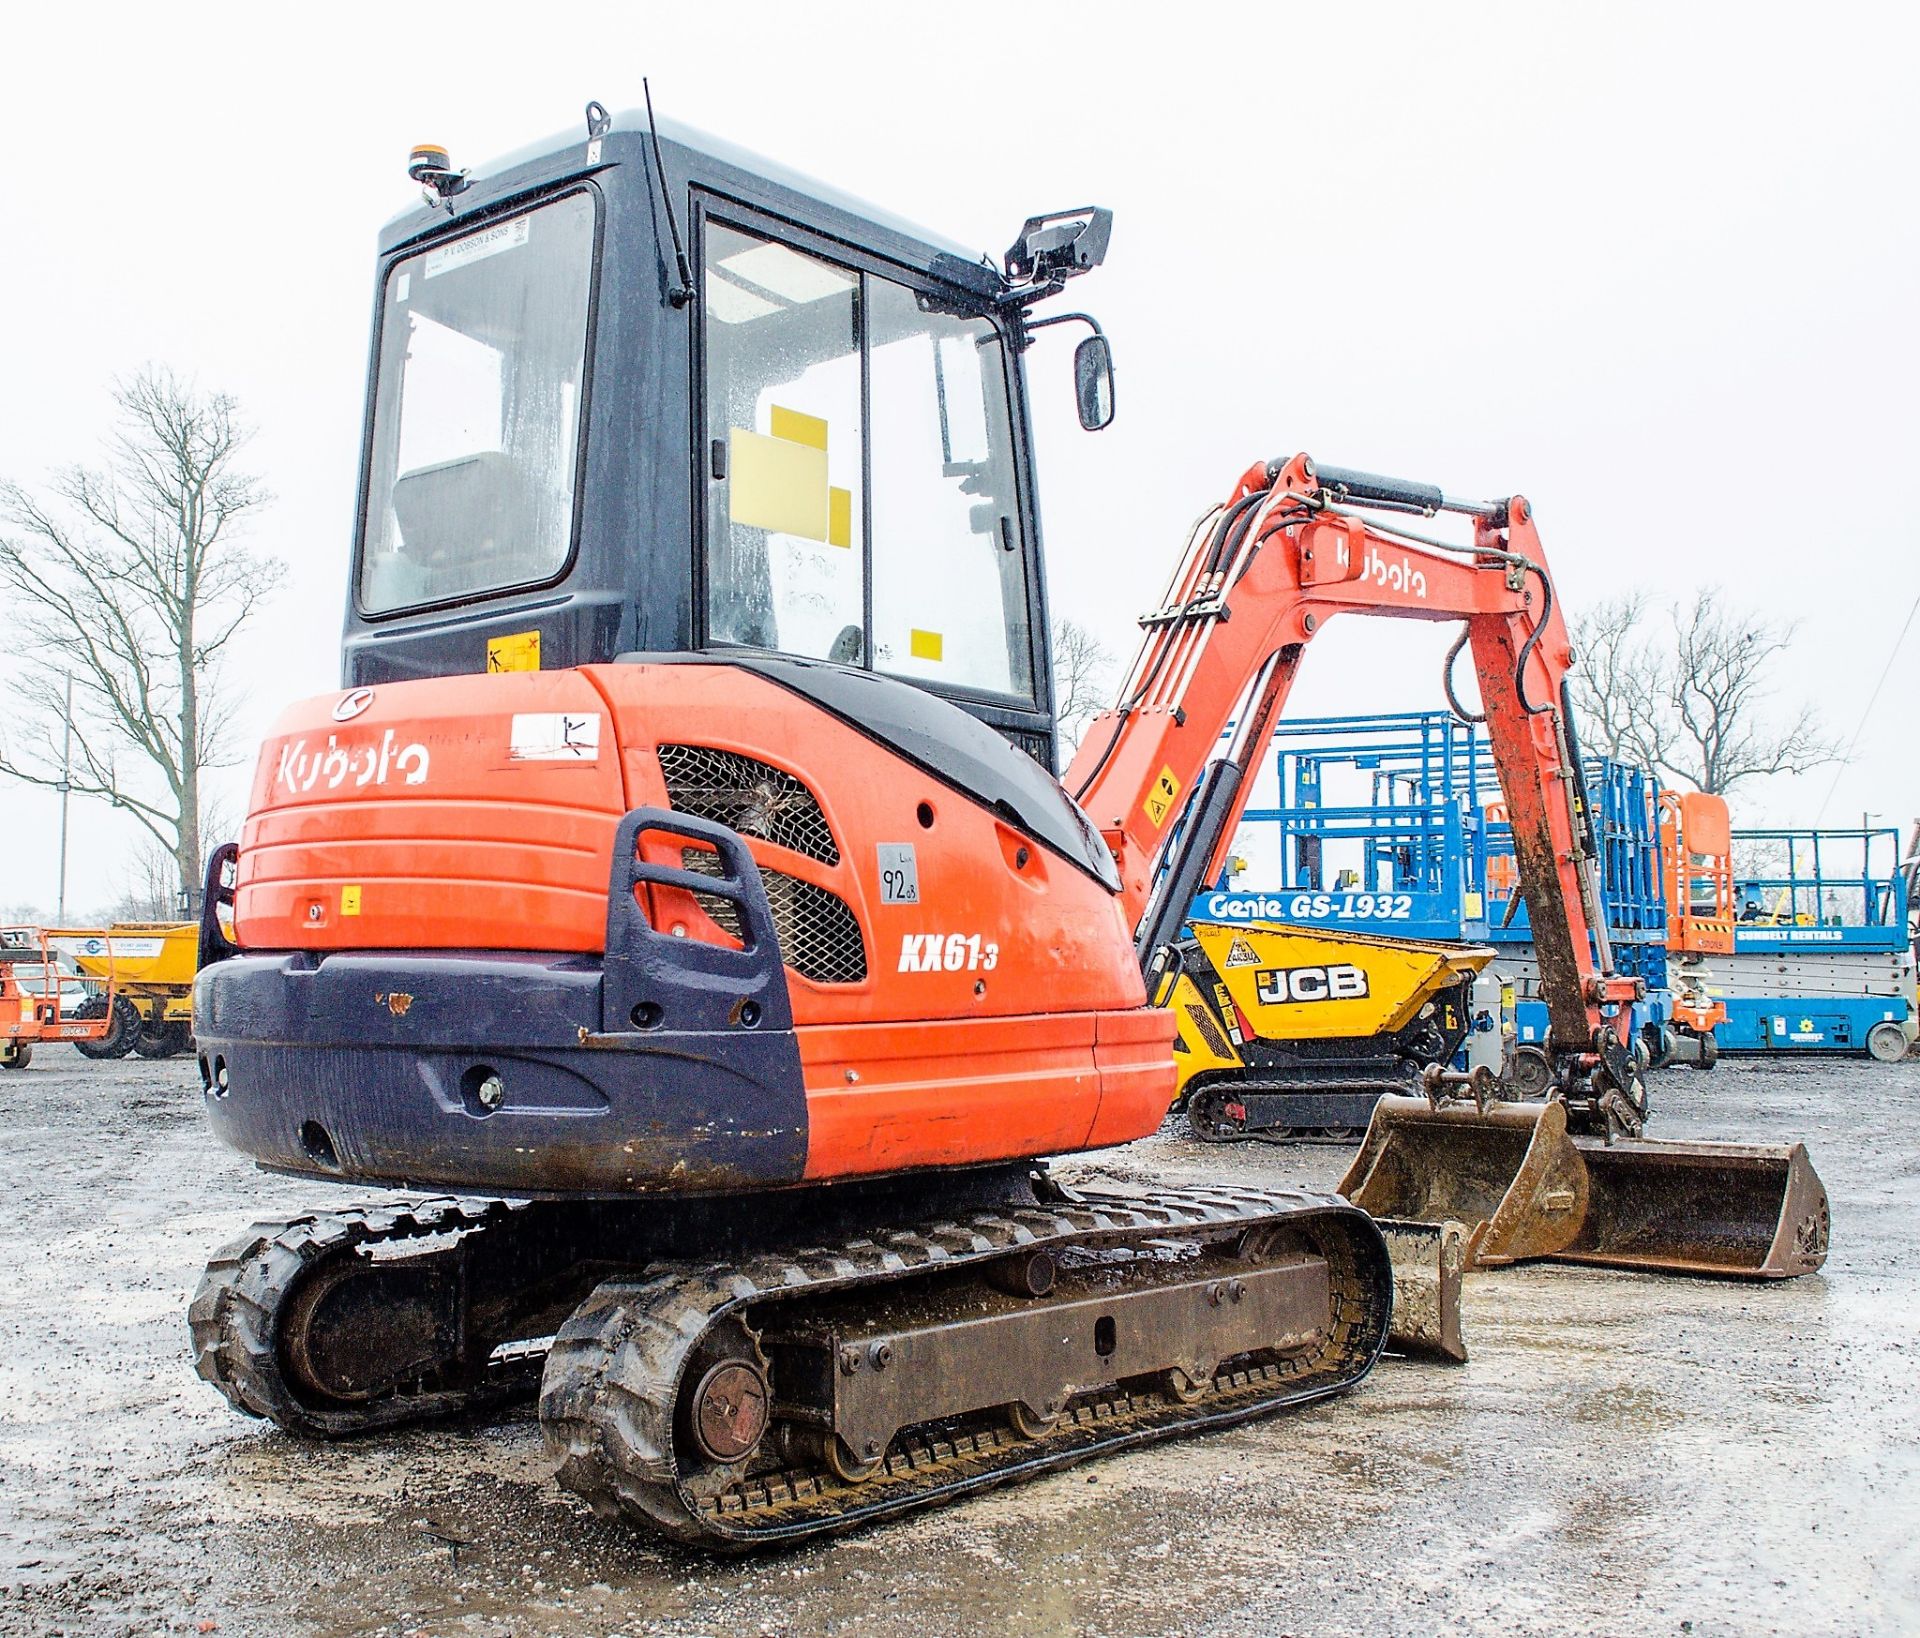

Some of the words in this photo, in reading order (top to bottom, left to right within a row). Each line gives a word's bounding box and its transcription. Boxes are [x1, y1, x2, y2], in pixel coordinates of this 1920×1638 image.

[277, 729, 430, 794] Kubota
[1208, 894, 1283, 918] Genie
[1290, 895, 1412, 919] GS-1932
[897, 933, 999, 972] KX61-3
[1790, 930, 1843, 941] RENTALS
[1258, 965, 1368, 1003] JCB
